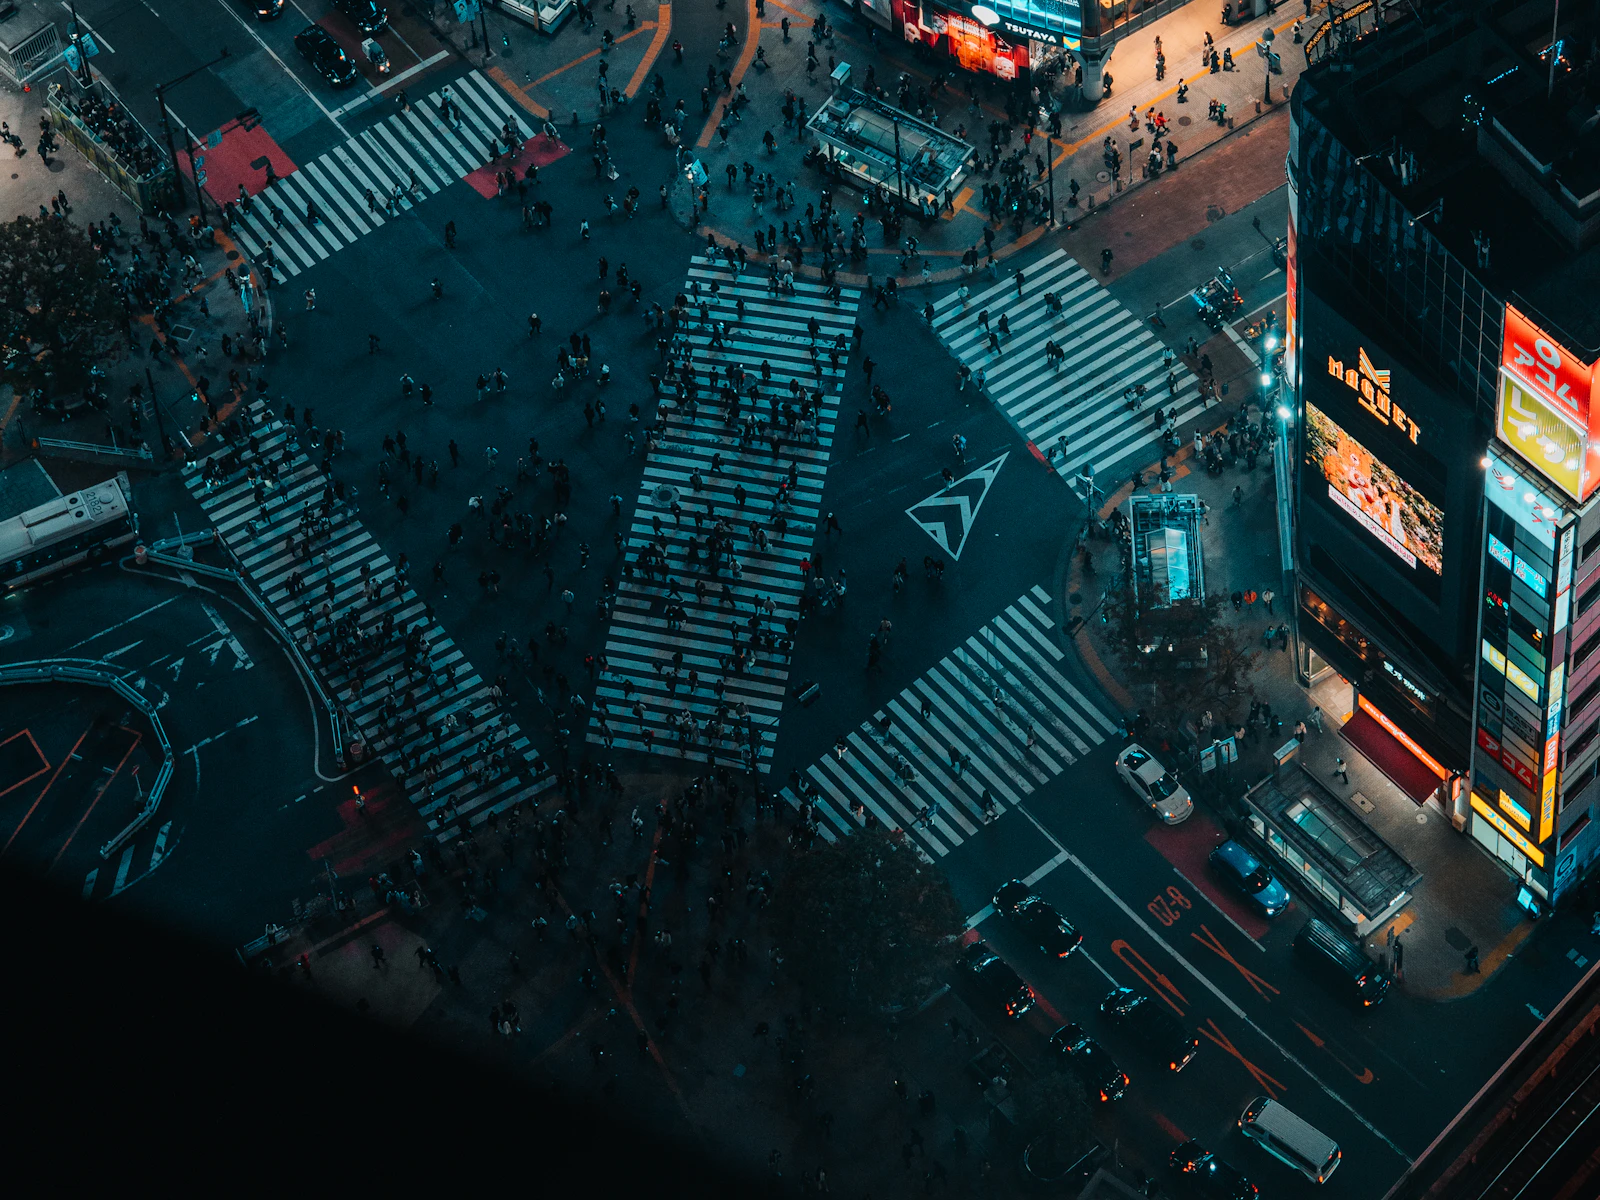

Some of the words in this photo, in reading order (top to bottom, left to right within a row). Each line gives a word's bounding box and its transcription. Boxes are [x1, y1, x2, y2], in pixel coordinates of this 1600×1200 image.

[1005, 21, 1057, 44] TSUTAYA
[1328, 355, 1421, 445] MAGNET
[1514, 341, 1579, 412] アコム
[1508, 385, 1566, 464] レイク
[86, 491, 103, 517] 21821
[1492, 646, 1535, 693] レイク
[1485, 735, 1532, 785] アコム
[1485, 808, 1529, 851] プロミス
